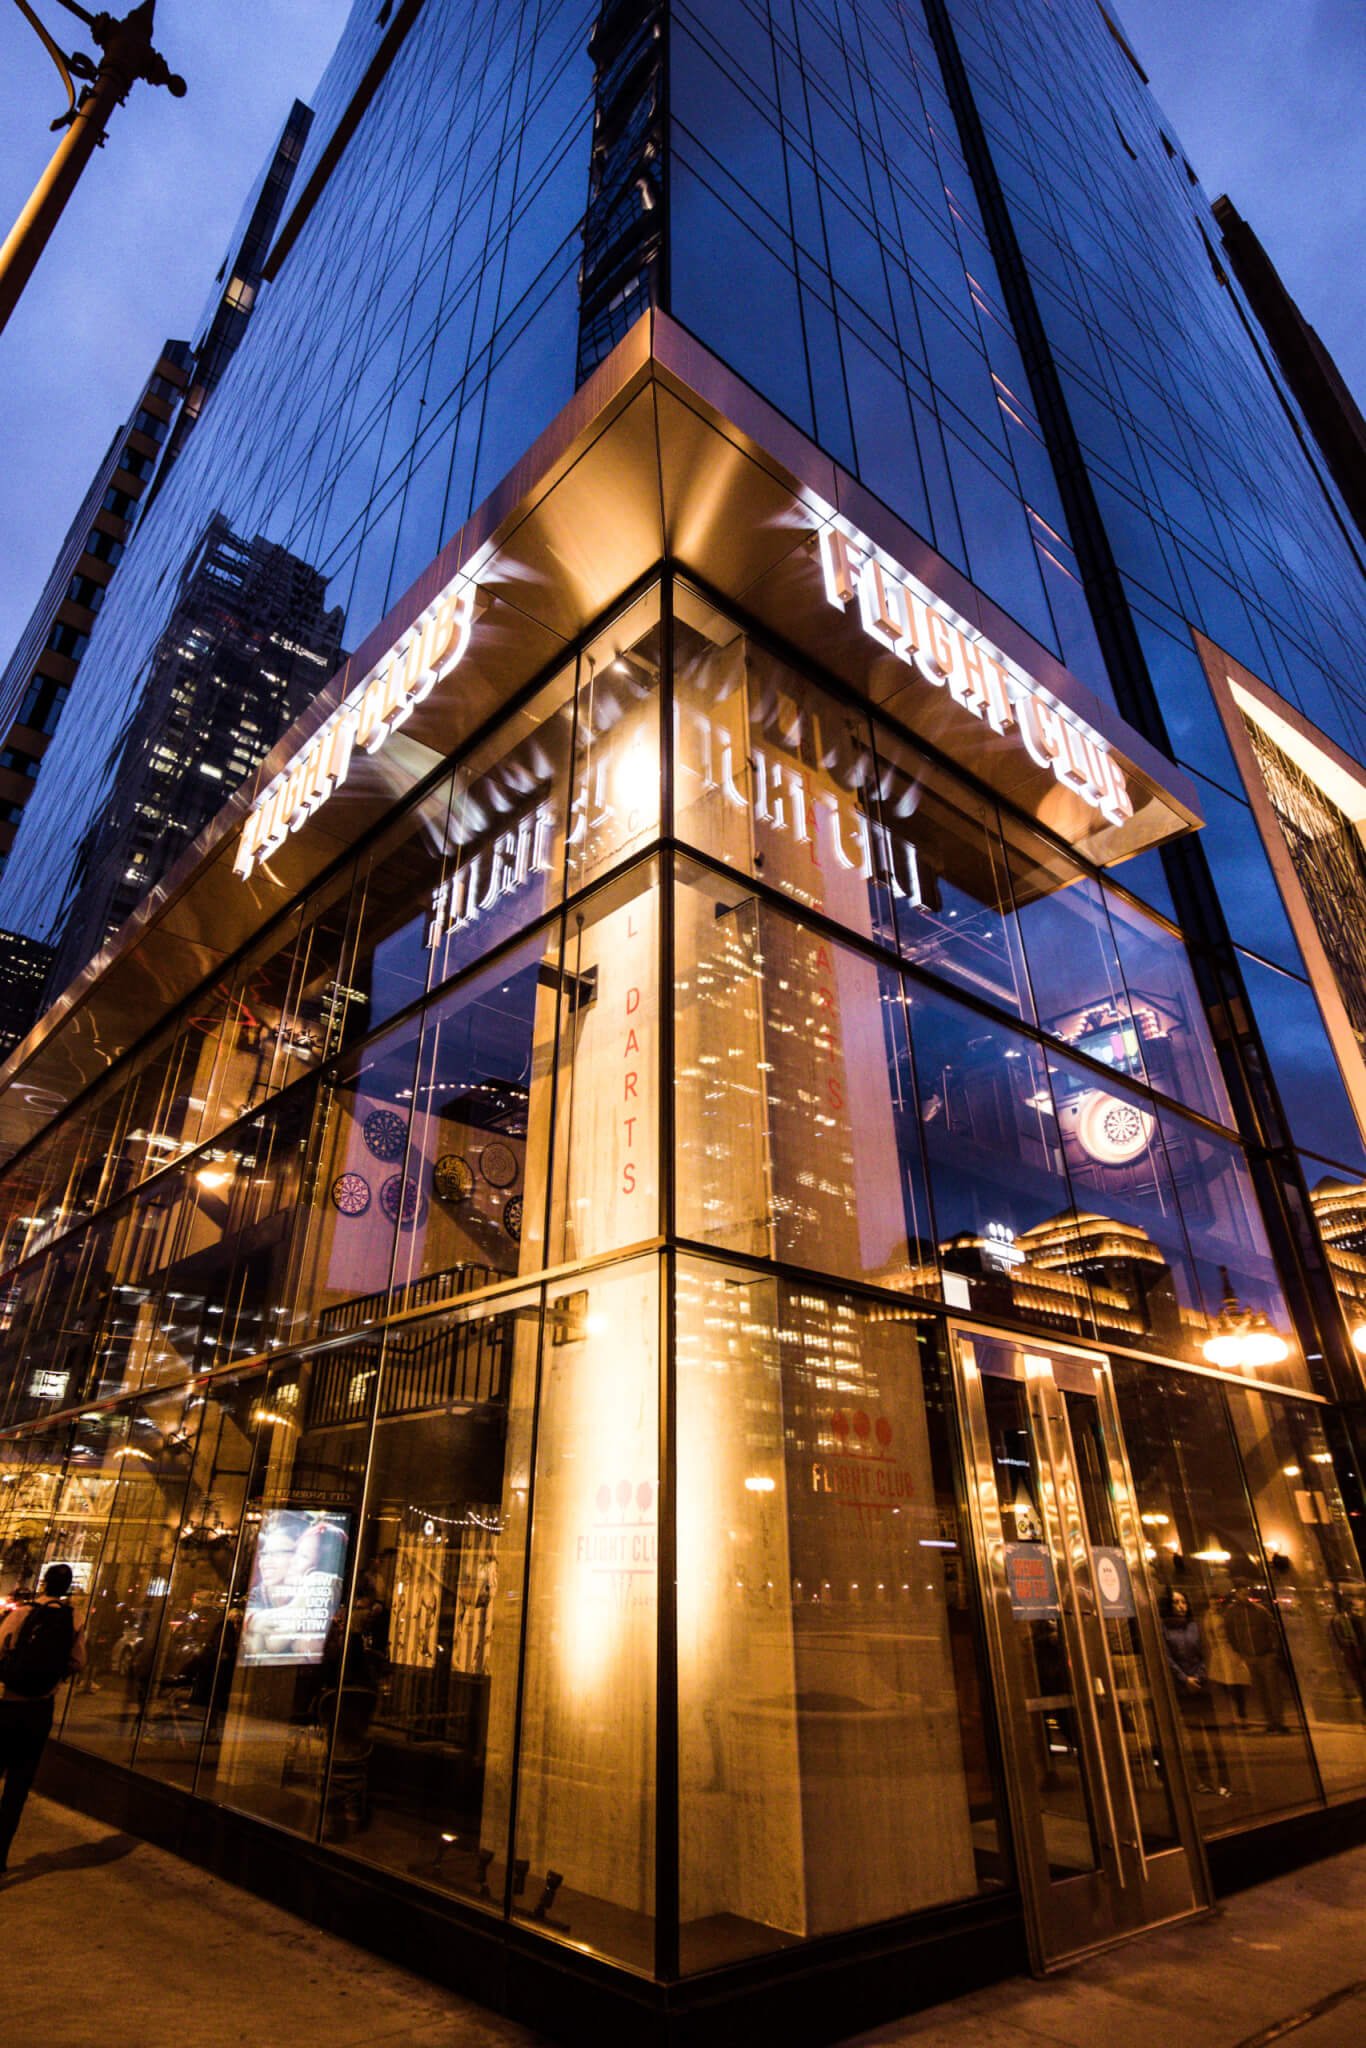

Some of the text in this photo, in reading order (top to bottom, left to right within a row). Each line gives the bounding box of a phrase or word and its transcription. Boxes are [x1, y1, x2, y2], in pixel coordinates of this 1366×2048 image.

[232, 592, 474, 881] FLIGHT CLUB
[822, 528, 1134, 828] FLIGHT CLUB
[621, 987, 641, 1196] DARTS
[577, 1535, 658, 1563] FLIGHT CLU
[812, 1462, 915, 1497] FLIGHT CLUB
